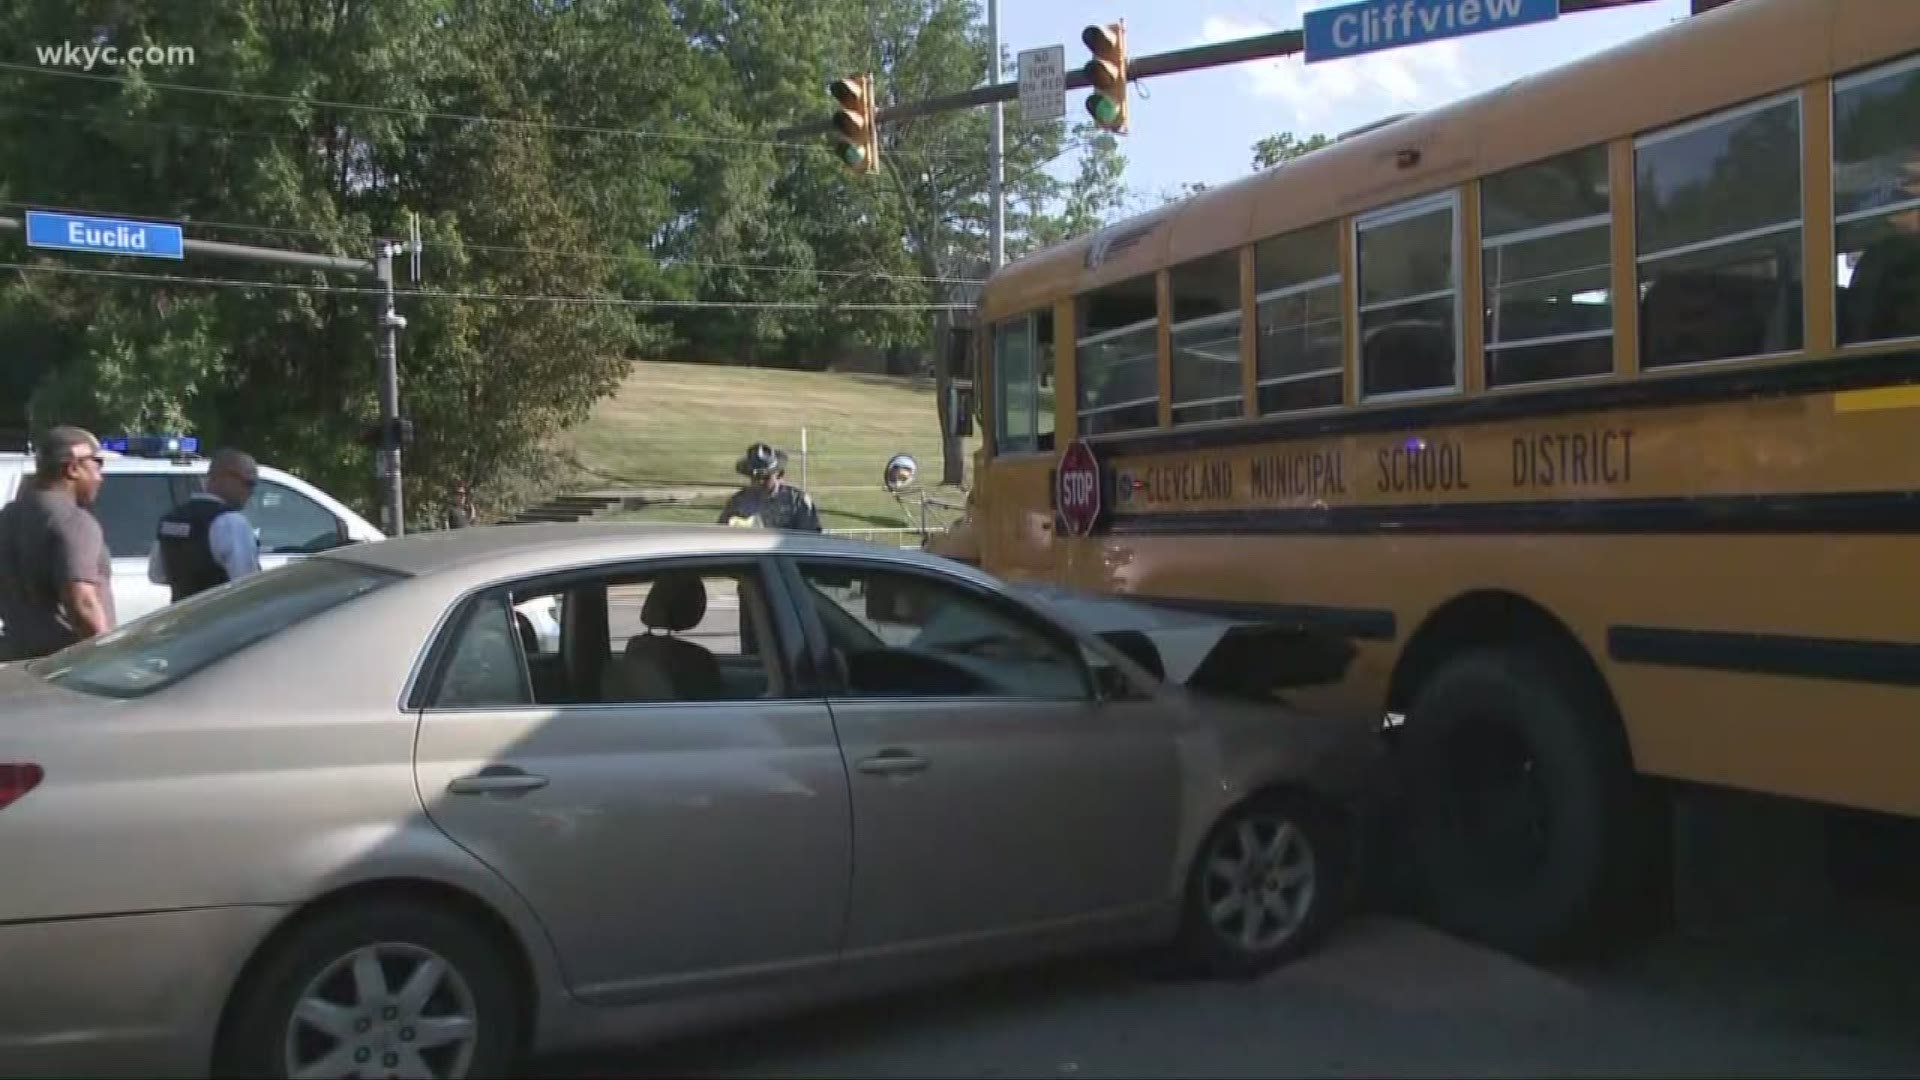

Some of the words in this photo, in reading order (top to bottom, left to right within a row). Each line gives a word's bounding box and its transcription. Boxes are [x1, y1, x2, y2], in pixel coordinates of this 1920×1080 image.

[1332, 0, 1522, 49] Cliffview
[68, 221, 146, 249] Euclid
[1146, 461, 1233, 503] CLEVELAND
[1251, 450, 1347, 498] MUNICIPAL
[1377, 442, 1470, 493] SCHOOL
[1512, 428, 1636, 488] DISTRICT
[1063, 472, 1093, 505] STOP
